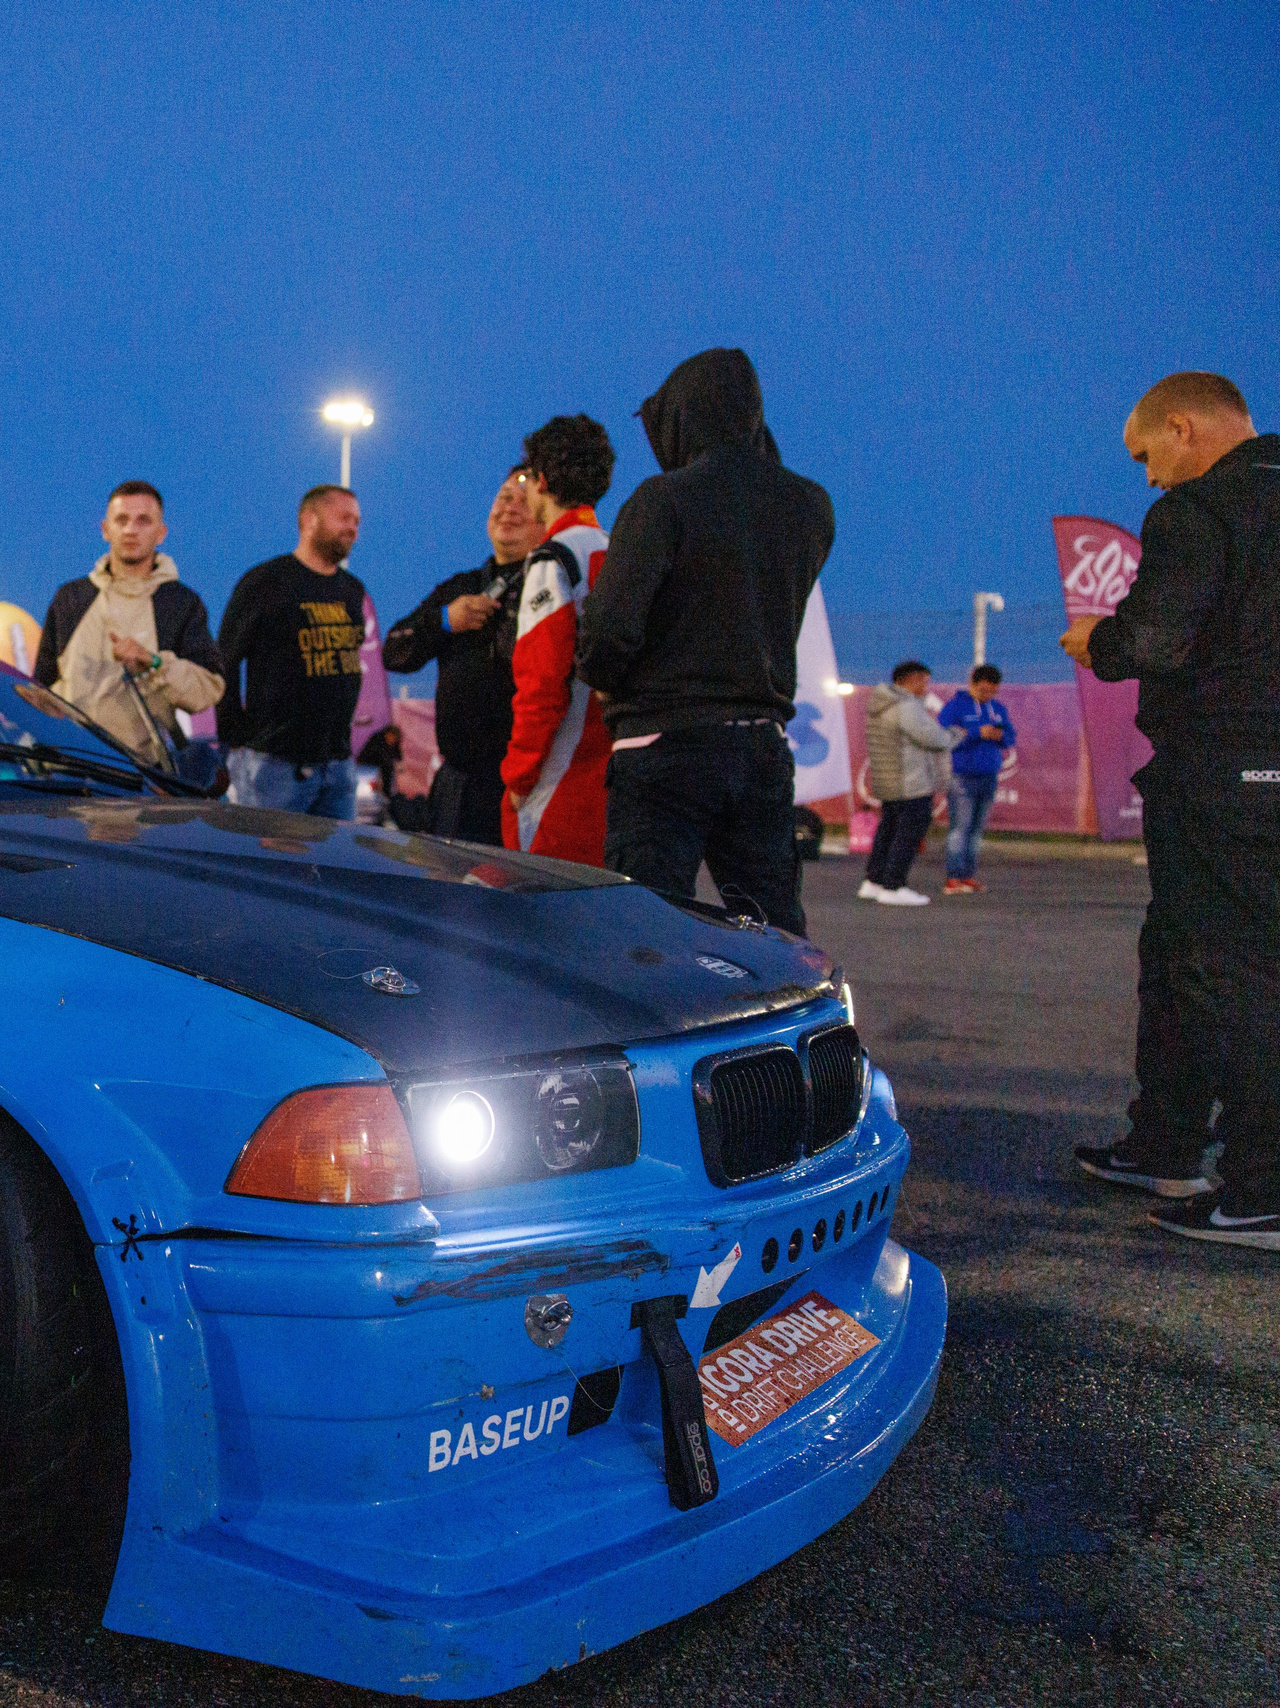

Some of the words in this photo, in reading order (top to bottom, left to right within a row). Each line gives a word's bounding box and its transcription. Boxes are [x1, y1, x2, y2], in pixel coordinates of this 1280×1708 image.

[301, 650, 340, 677] THE
[699, 1340, 782, 1399] IGORA
[760, 1300, 841, 1356] DRIVE
[731, 1376, 790, 1423] DRIFT
[776, 1325, 868, 1390] CHALLENGE
[428, 1395, 570, 1473] BASEUP
[688, 1422, 713, 1494] sparco
